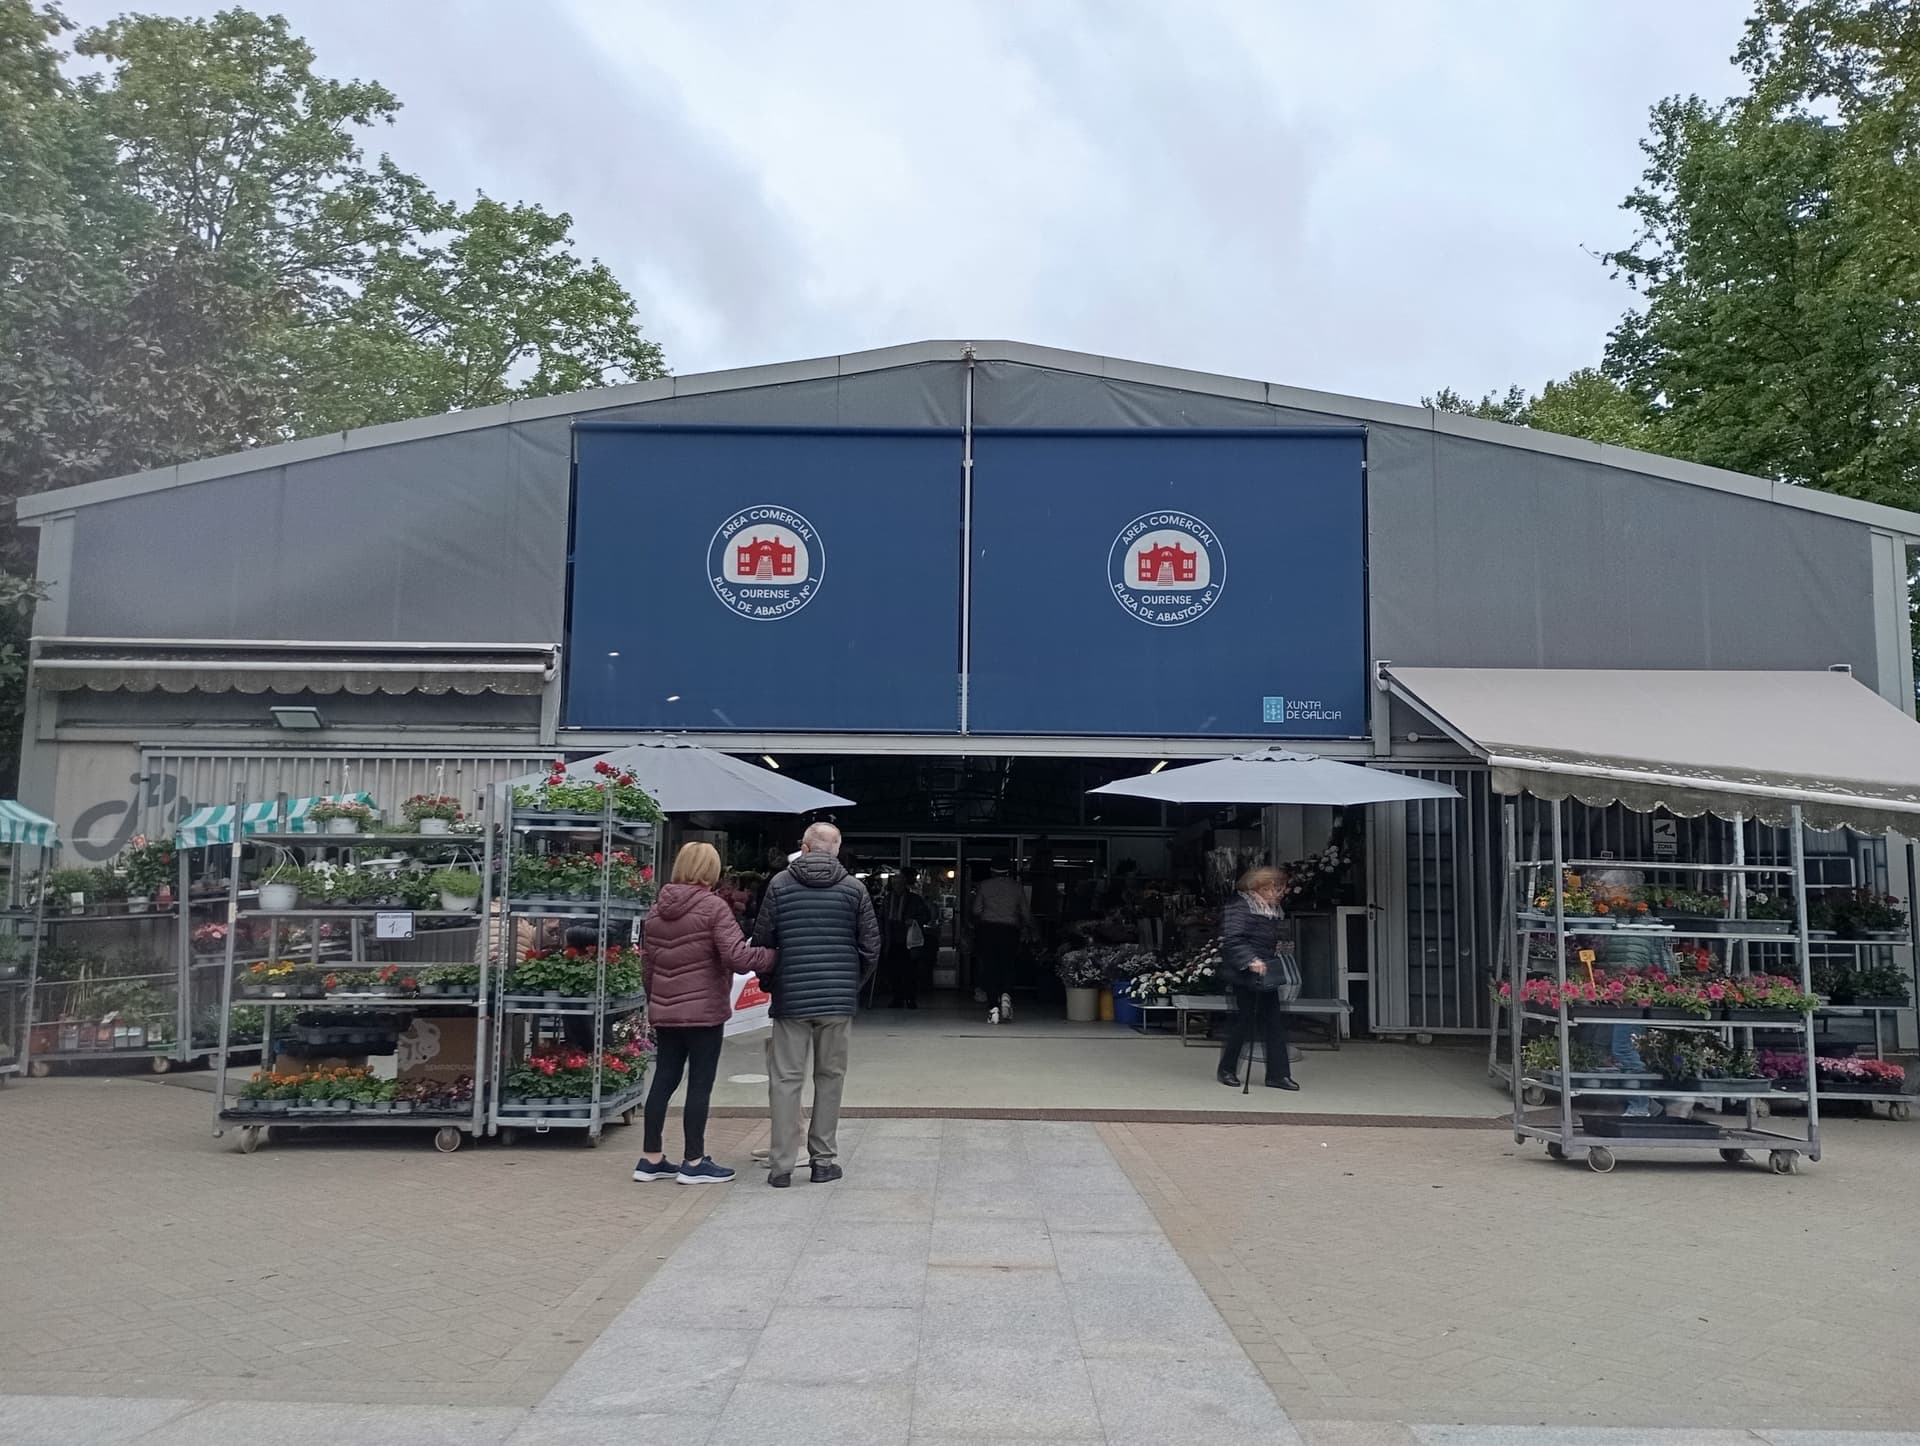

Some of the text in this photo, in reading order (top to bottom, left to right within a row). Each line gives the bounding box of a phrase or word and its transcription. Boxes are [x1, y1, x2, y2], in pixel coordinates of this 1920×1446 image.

[721, 509, 813, 542] AREA COMERCIAL
[1121, 515, 1213, 547] AREA COMERCIAL
[712, 576, 736, 605] PLAZA
[737, 600, 752, 613] DE
[753, 596, 801, 616] ABASTOS
[739, 588, 791, 599] OURENSE
[1114, 582, 1138, 611] PLAZA
[1139, 606, 1154, 619] DE
[1155, 602, 1203, 622] ABASTOS
[1141, 595, 1192, 605] OURENSE
[1287, 701, 1321, 710] XUNTA
[1287, 711, 1341, 719] DE GALICIA
